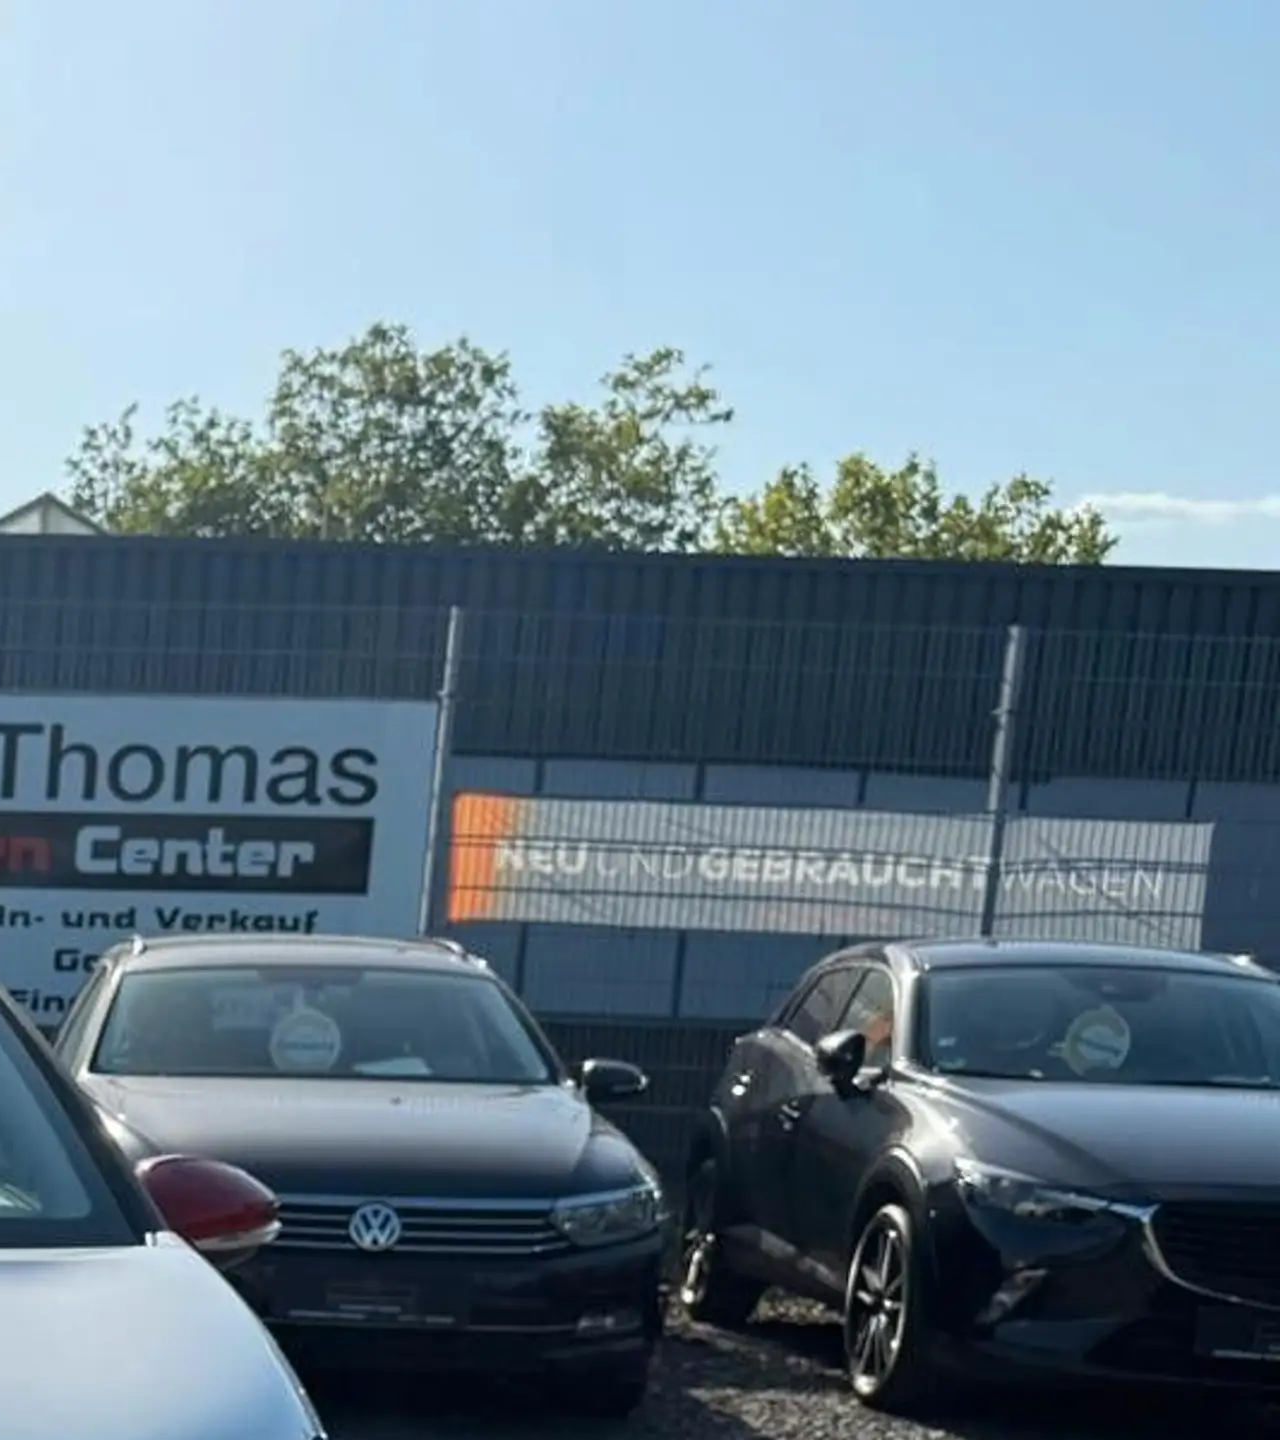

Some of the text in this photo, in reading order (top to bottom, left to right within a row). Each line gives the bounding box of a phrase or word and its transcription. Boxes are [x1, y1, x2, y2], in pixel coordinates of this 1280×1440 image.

[73, 824, 316, 877] Center
[61, 906, 137, 930] und
[154, 906, 320, 935] Verkauf
